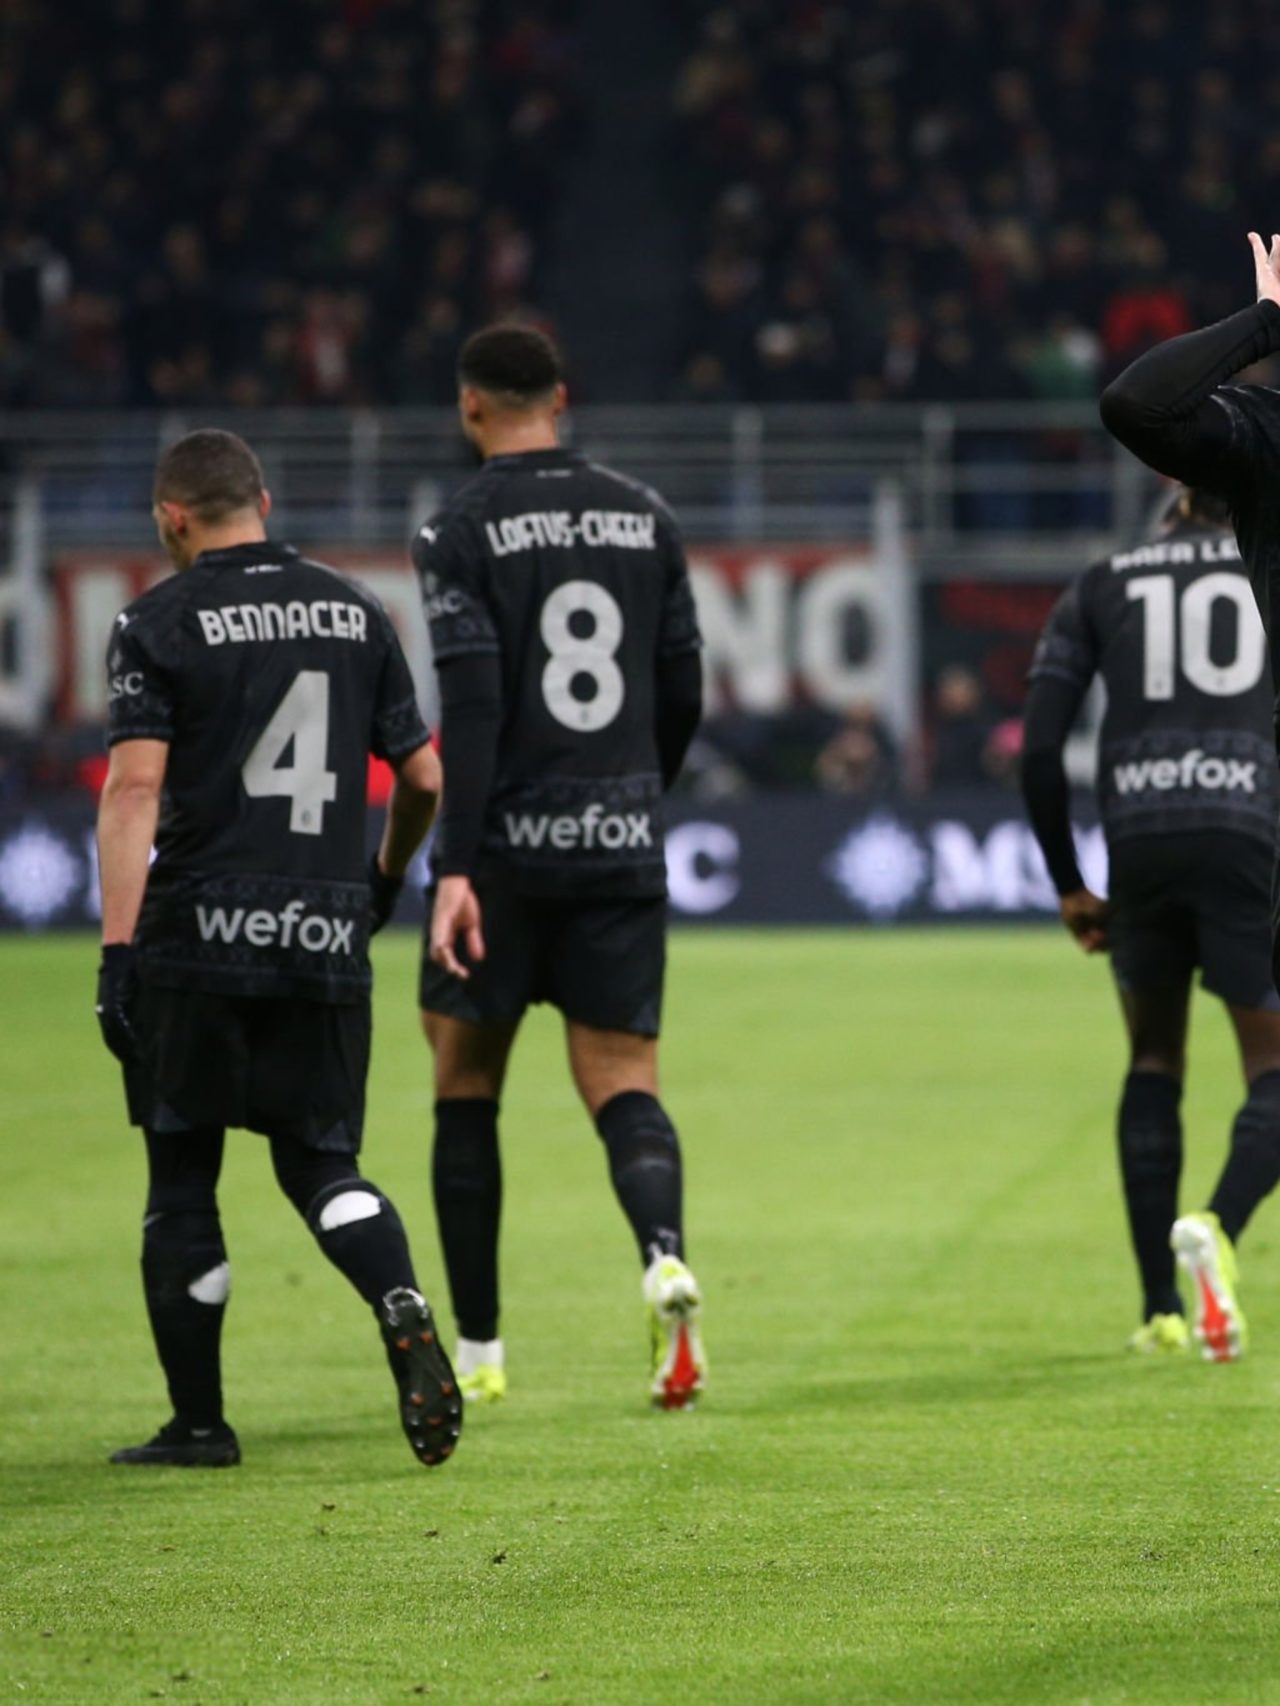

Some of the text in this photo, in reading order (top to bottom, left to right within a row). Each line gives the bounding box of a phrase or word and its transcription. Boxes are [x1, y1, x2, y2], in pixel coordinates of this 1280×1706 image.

[485, 510, 656, 557] LOFTUS-CHEEK
[198, 601, 367, 645] BENNACER
[1126, 571, 1267, 700] 10
[540, 579, 625, 733] 8
[111, 670, 145, 700] SC
[241, 670, 337, 835] 4
[1113, 748, 1257, 794] wefox
[505, 804, 652, 849] wefox
[195, 900, 354, 955] wefox
